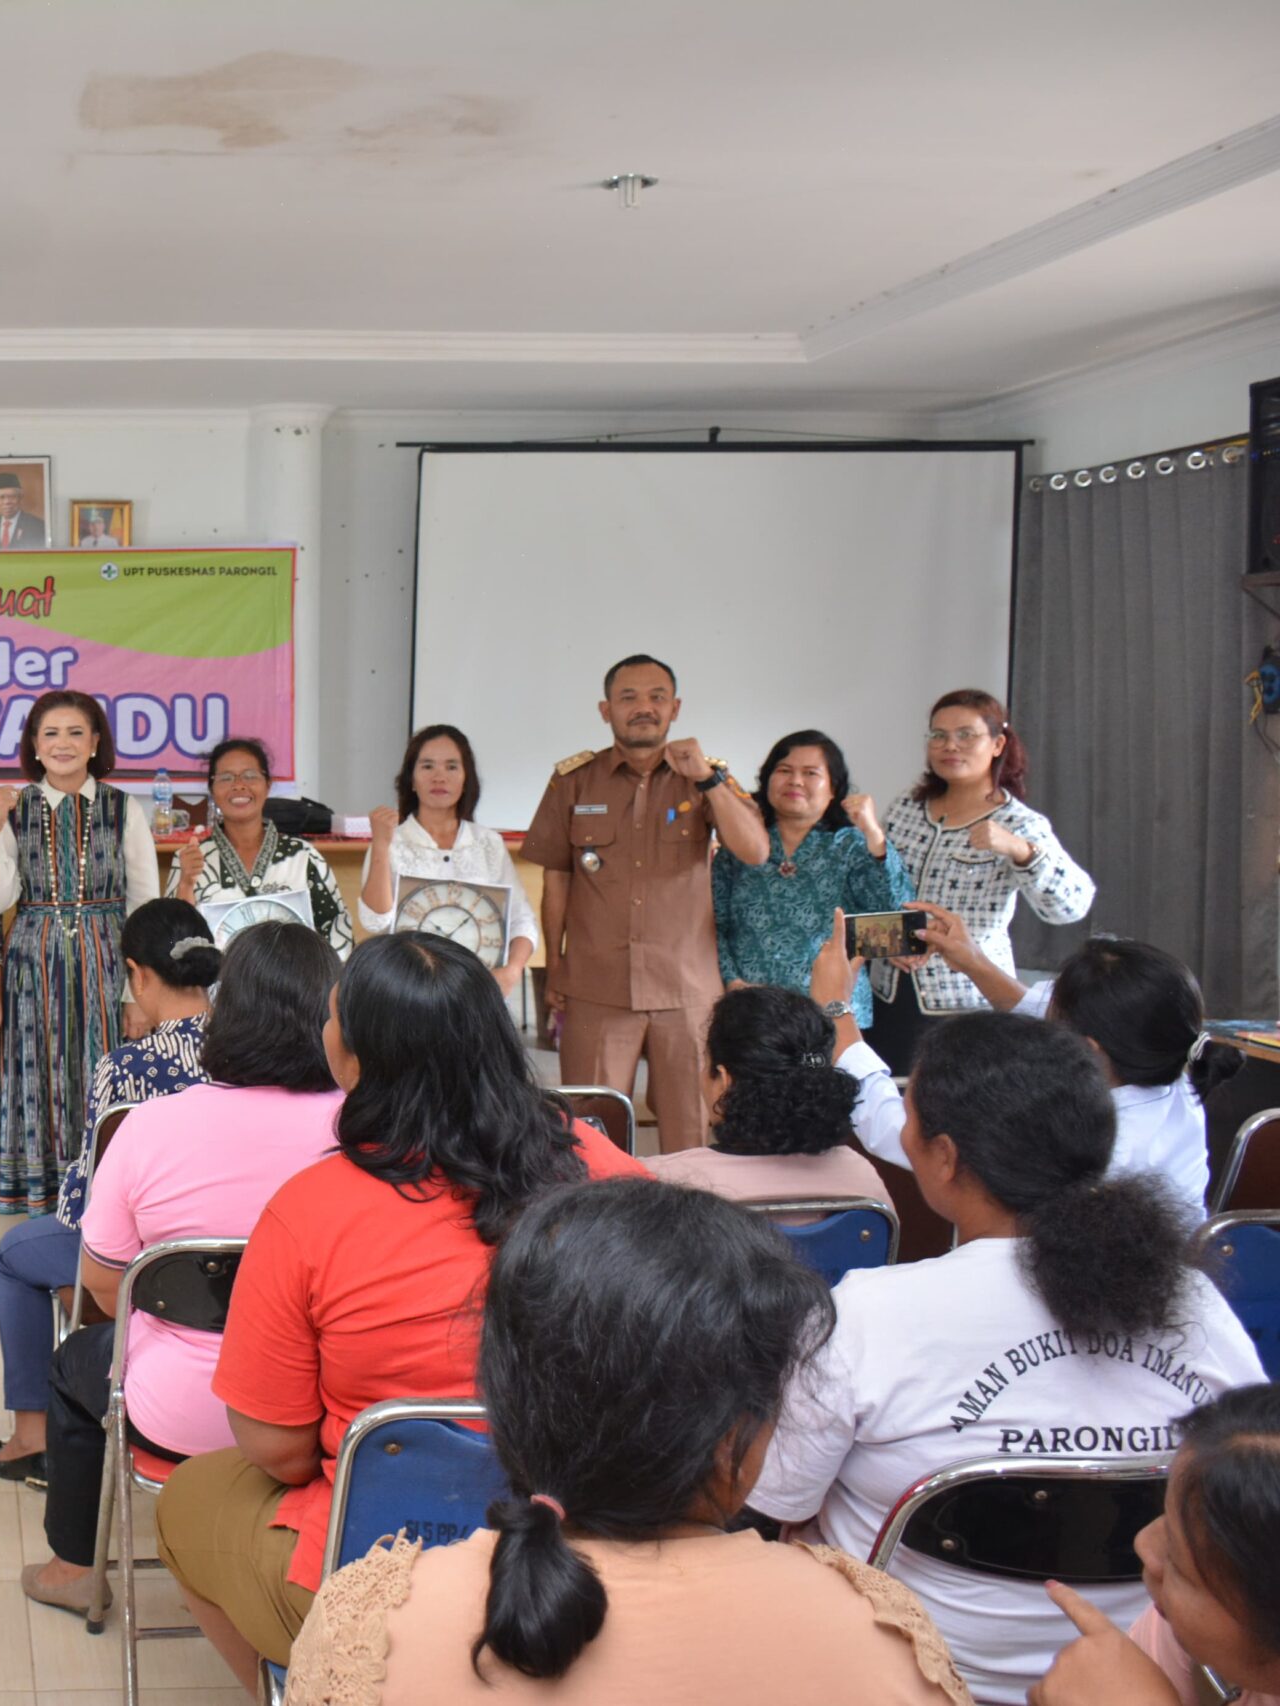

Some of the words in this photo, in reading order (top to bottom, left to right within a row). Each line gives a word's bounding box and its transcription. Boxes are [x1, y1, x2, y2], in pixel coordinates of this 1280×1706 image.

[123, 567, 144, 576] UPT
[147, 566, 216, 576] PUSKESMAS
[219, 566, 278, 576] PARONGIL
[1004, 1329, 1078, 1377] BUKIT
[1087, 1329, 1135, 1364] DOA
[1141, 1344, 1214, 1405] IMANU
[998, 1425, 1181, 1453] PARONGIL
